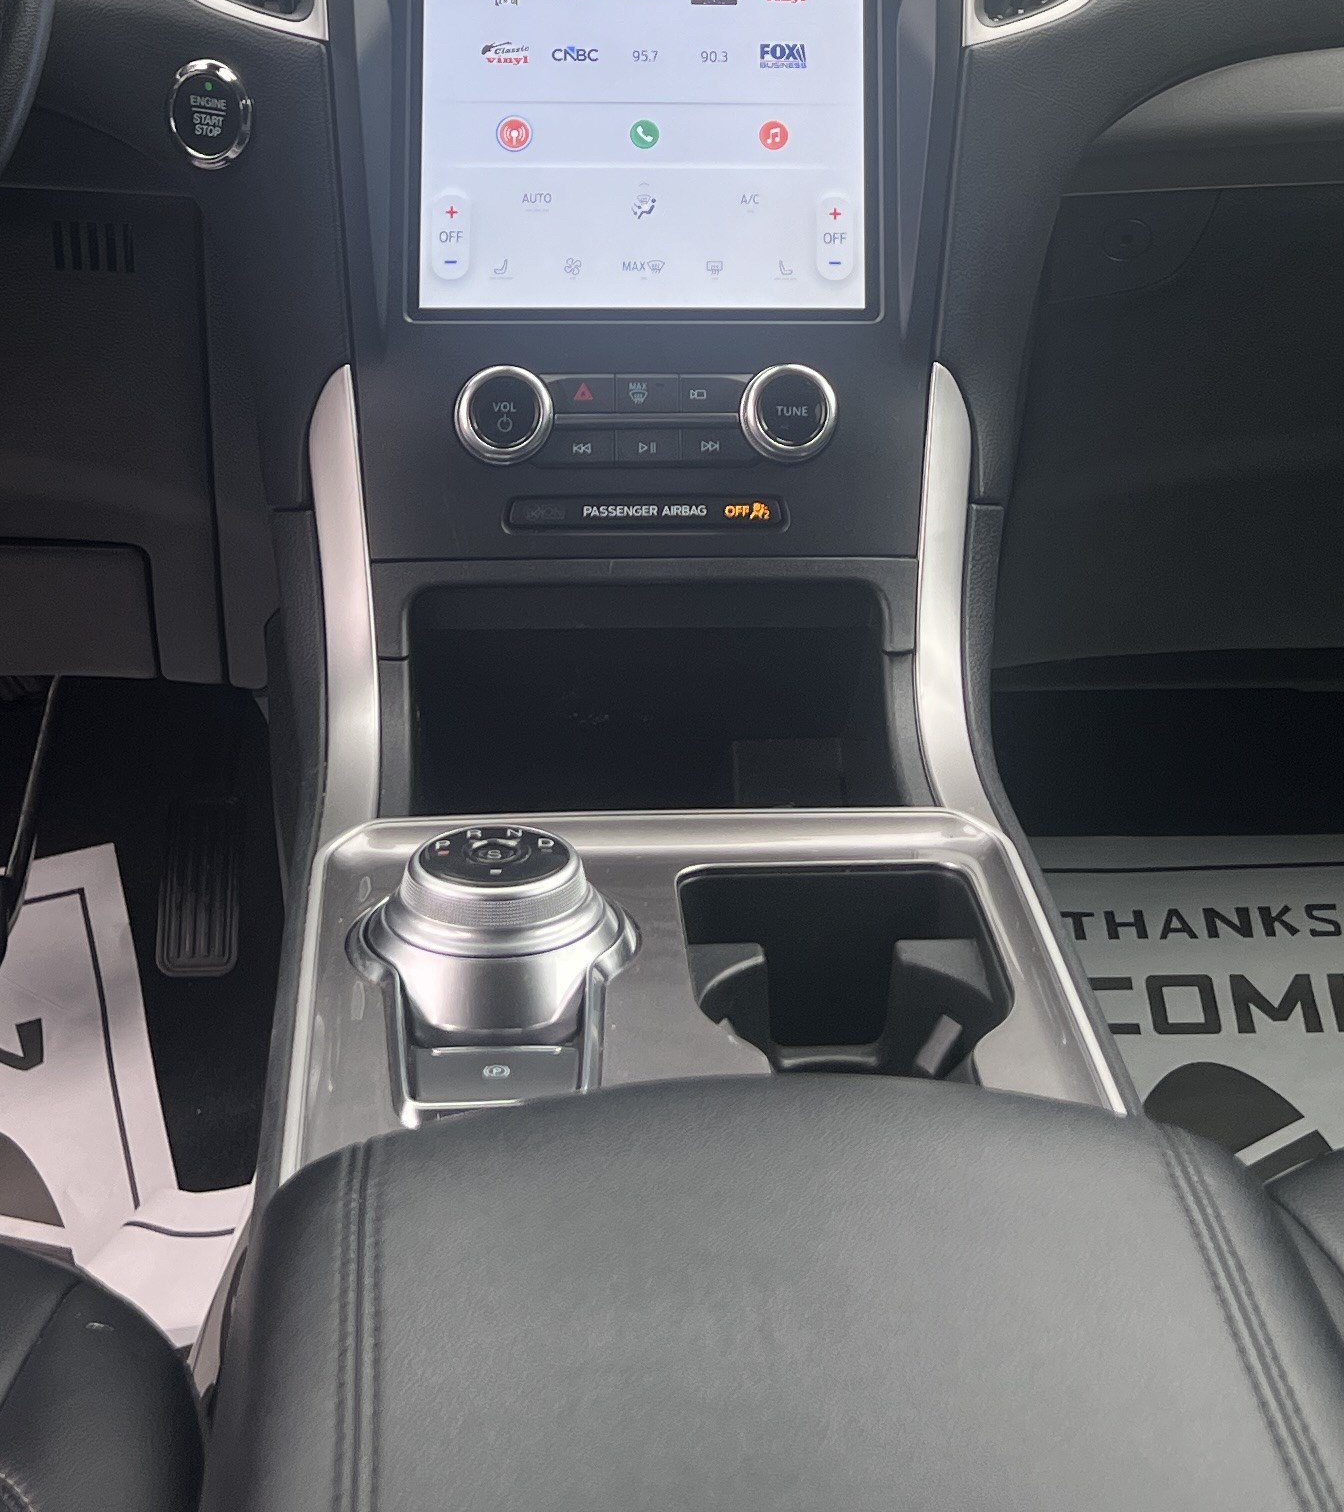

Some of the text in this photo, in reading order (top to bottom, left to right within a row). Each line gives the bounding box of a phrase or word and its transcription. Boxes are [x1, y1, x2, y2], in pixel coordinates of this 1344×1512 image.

[494, 45, 530, 55] Classic
[551, 46, 599, 62] CNBC
[632, 49, 659, 63] 95.7
[759, 43, 798, 61] FOX
[486, 55, 530, 65] vinyl
[700, 50, 729, 64] 90.3
[759, 61, 807, 69] BUSINESS
[189, 95, 227, 110] ENGINE
[193, 113, 224, 127] START
[194, 124, 222, 137] STOP
[522, 192, 552, 204] AUTO
[740, 194, 760, 205] A/C
[439, 230, 463, 243] OFF
[823, 232, 847, 245] OFF
[622, 260, 646, 272] MAX
[628, 382, 648, 391] MAX
[492, 401, 516, 413] VOL
[776, 405, 809, 417] TUNE
[582, 505, 749, 518] PASSENGER AIRBAG OFF
[466, 829, 482, 838] R
[506, 828, 523, 837] N
[435, 840, 451, 849] P
[537, 838, 555, 848] D
[1061, 902, 1343, 941] THANKS
